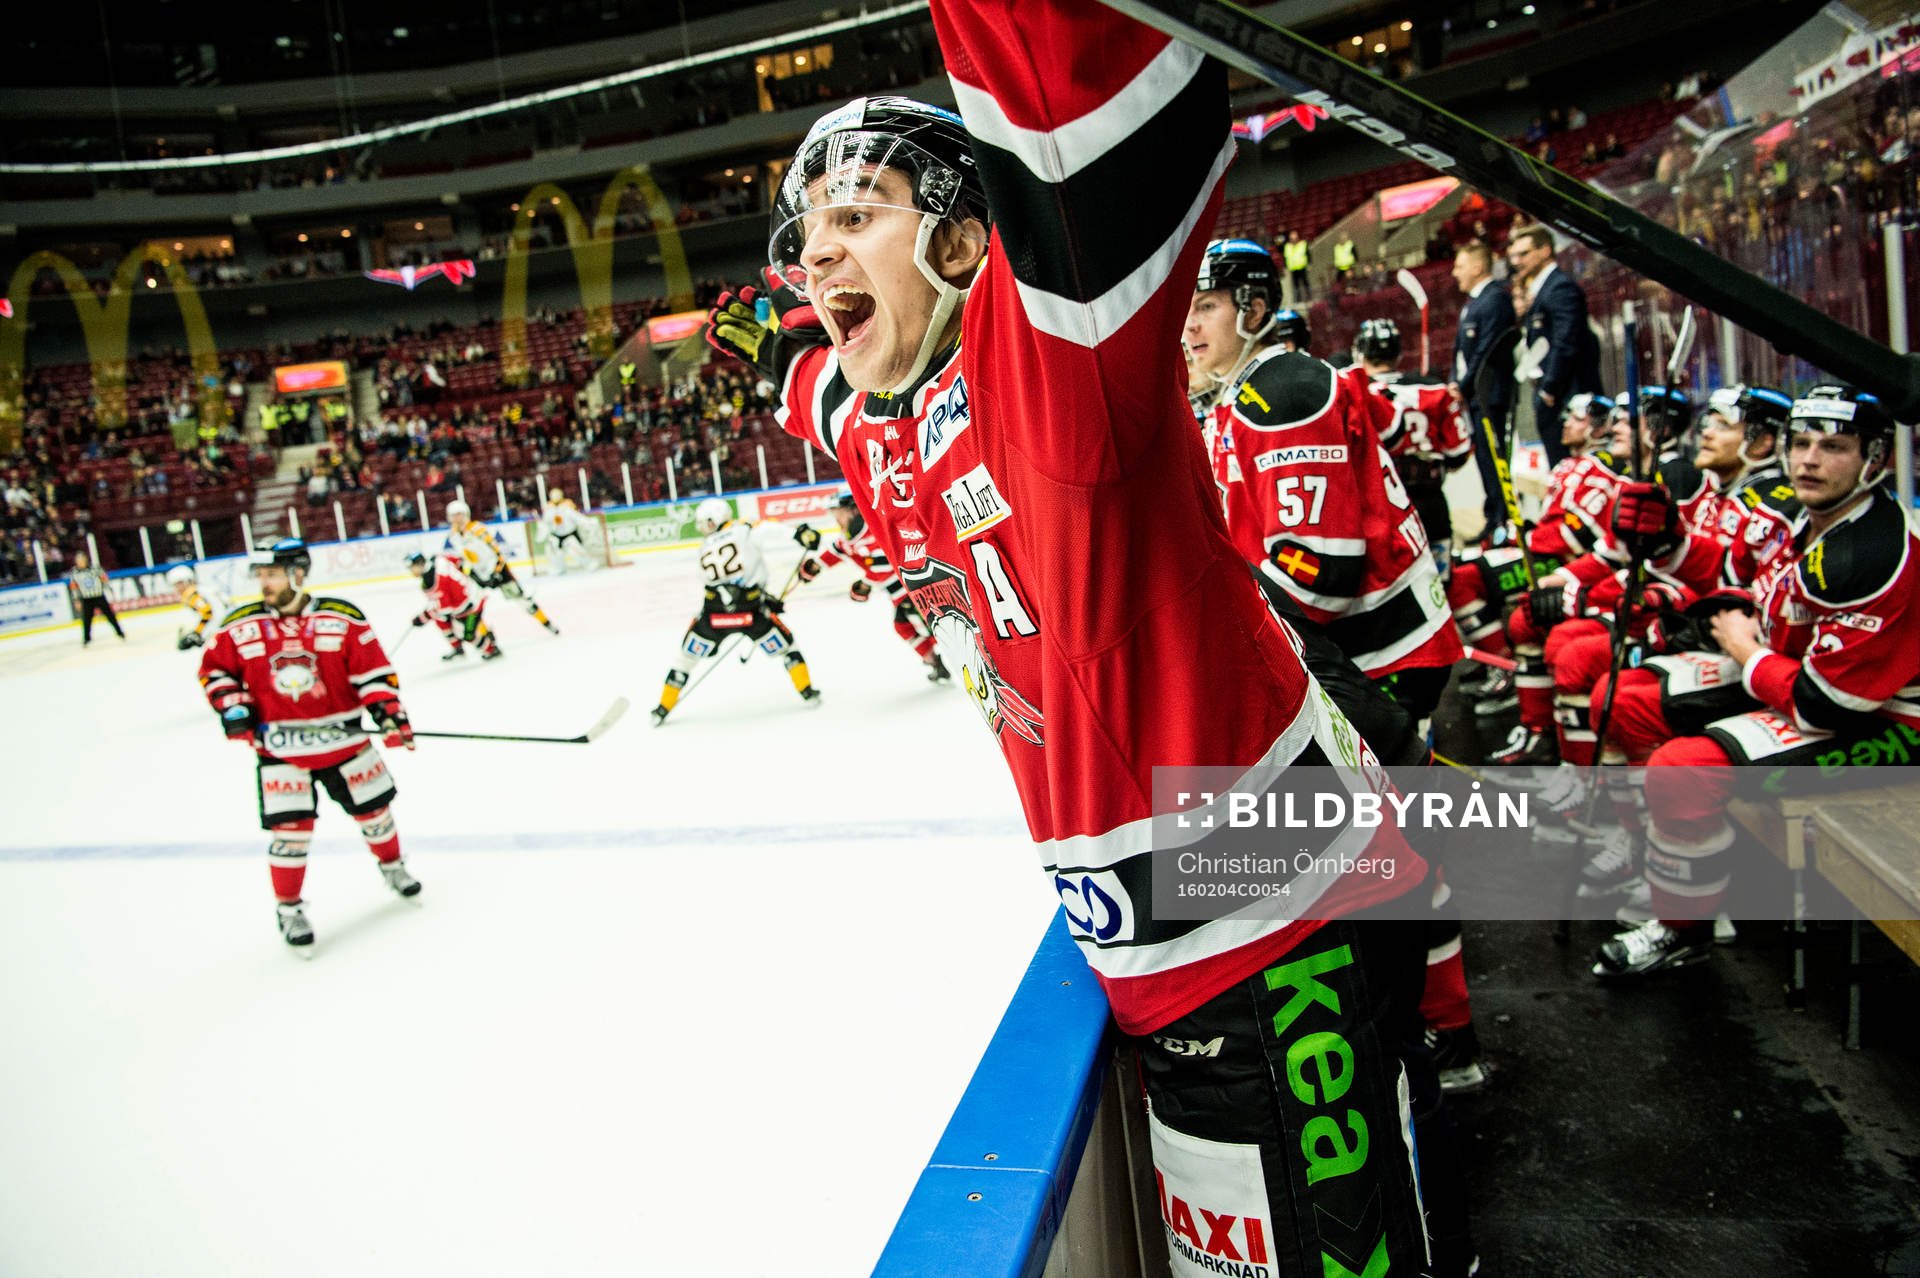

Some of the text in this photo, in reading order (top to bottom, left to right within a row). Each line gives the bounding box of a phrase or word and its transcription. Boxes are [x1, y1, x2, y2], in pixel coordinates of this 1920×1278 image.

[1294, 90, 1456, 170] CCM
[1276, 473, 1328, 529] 57
[700, 542, 743, 582] 52
[968, 537, 1041, 642] A
